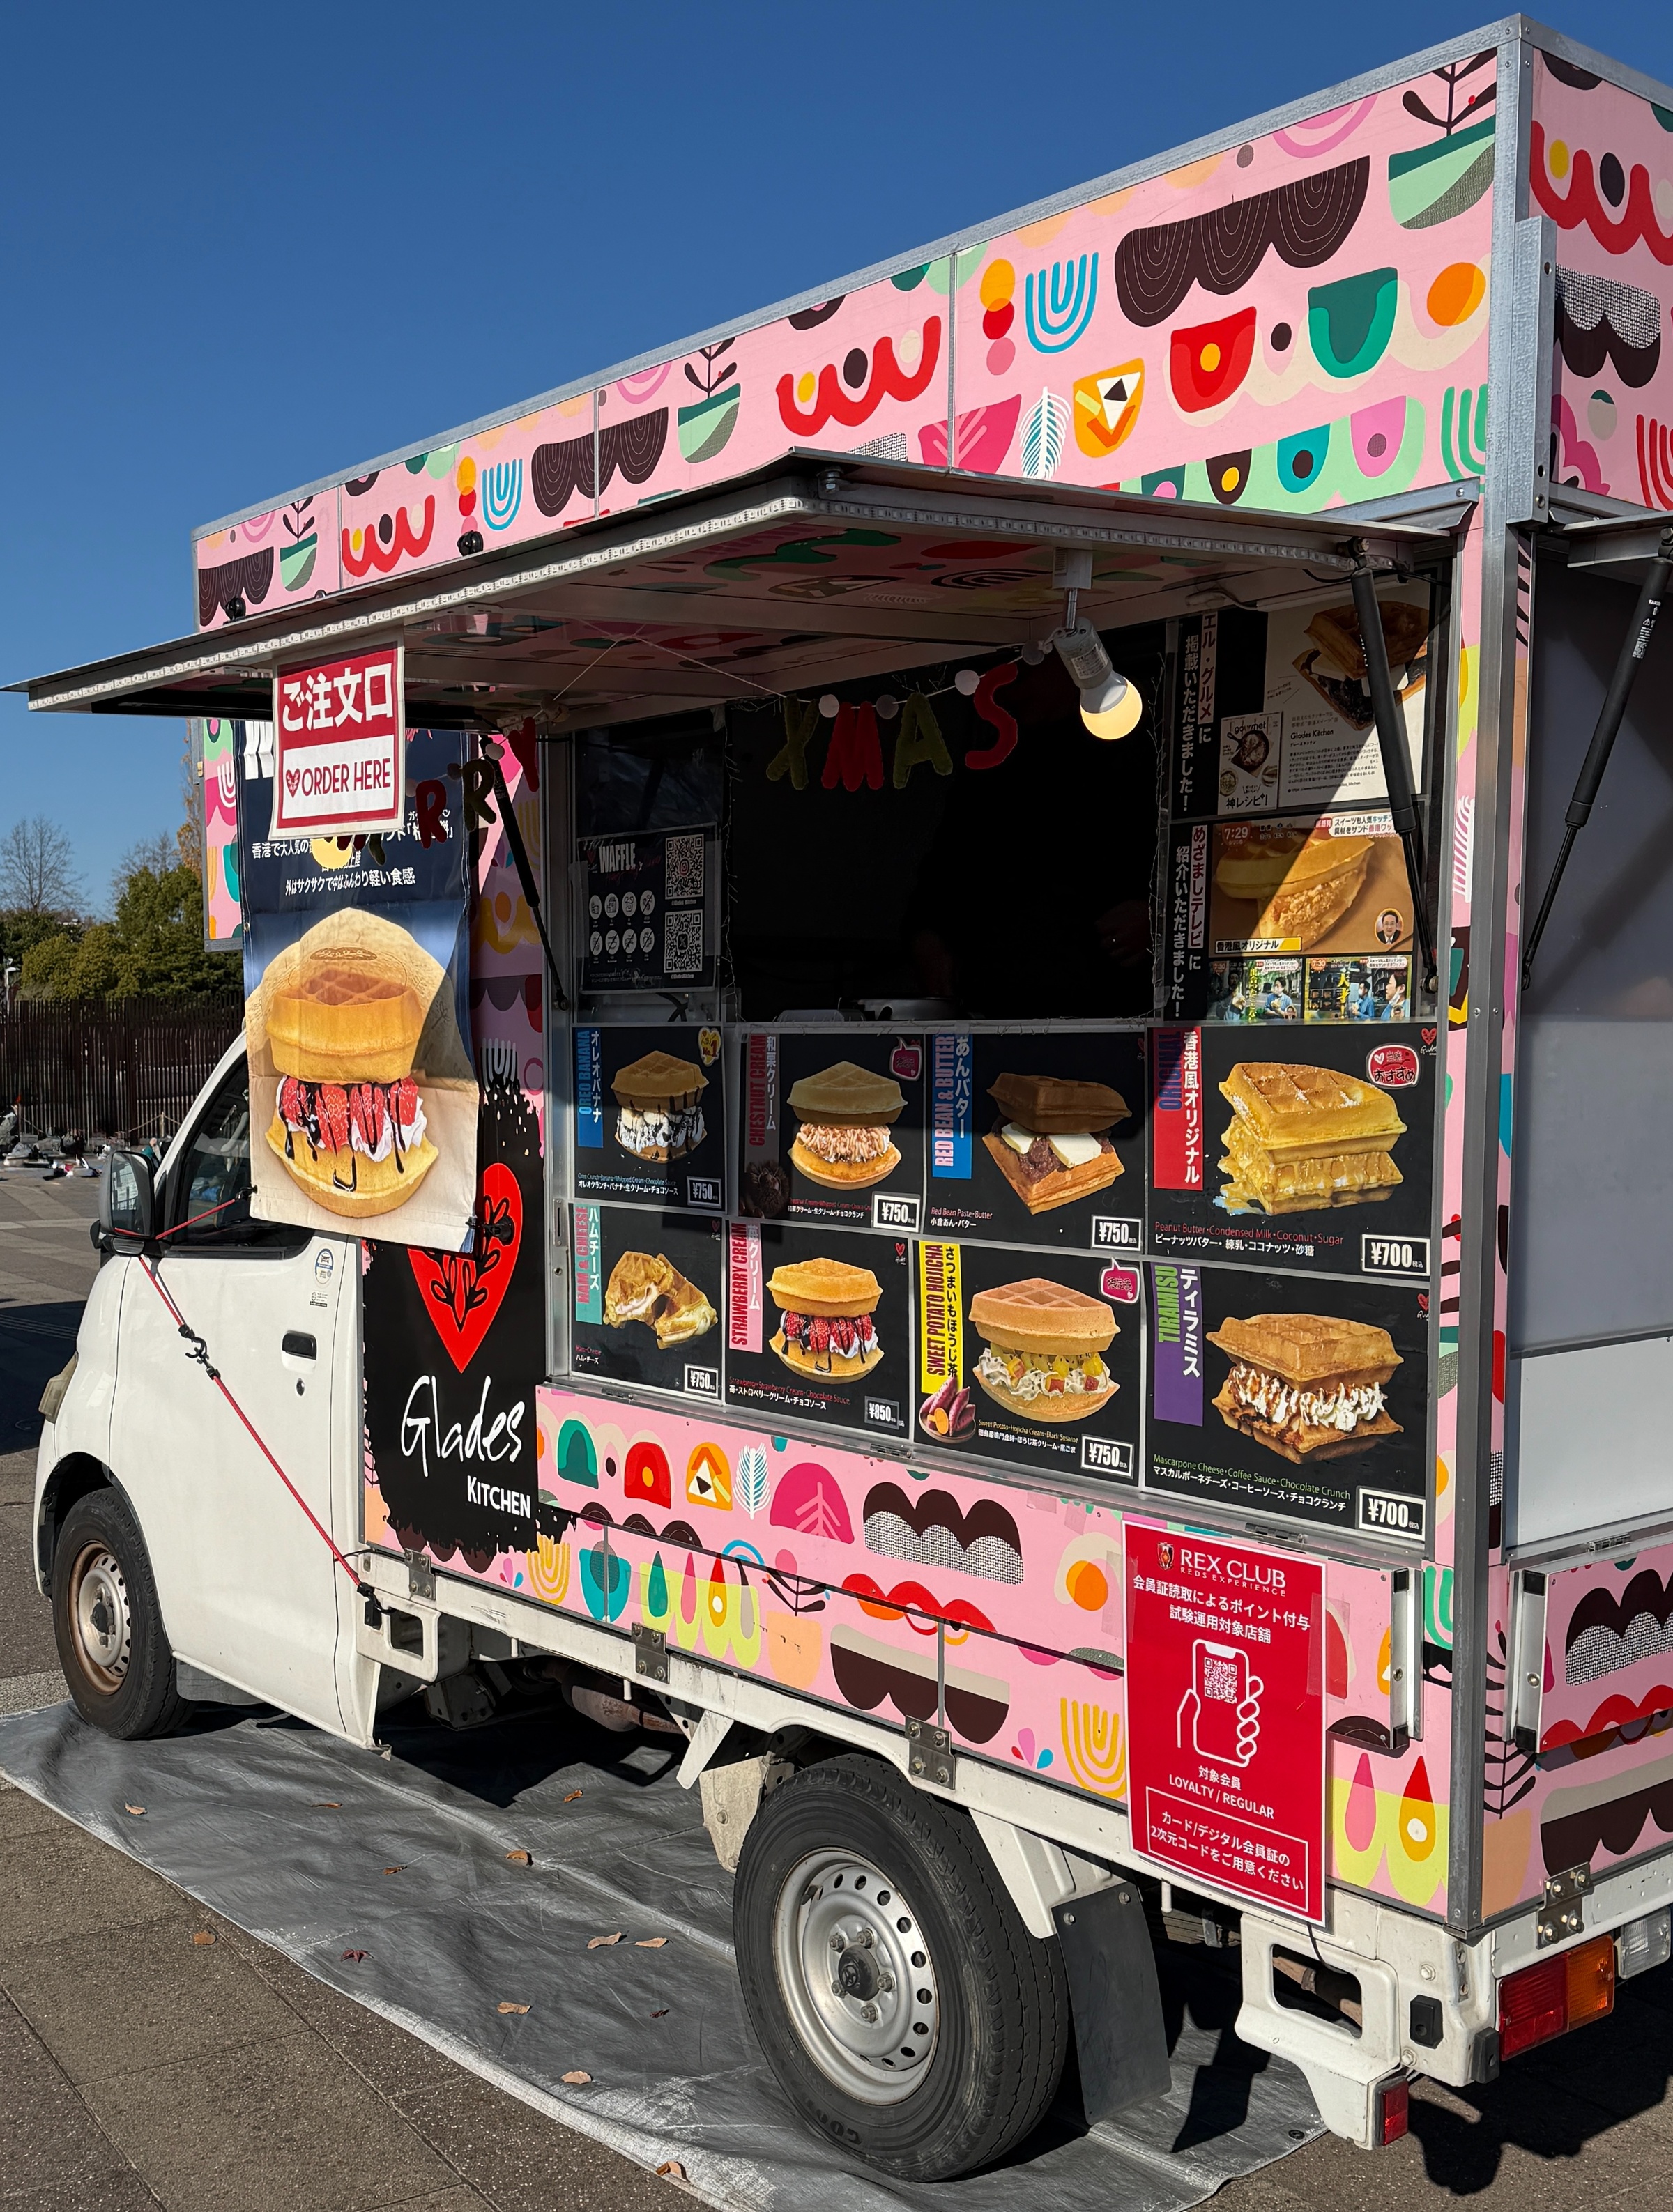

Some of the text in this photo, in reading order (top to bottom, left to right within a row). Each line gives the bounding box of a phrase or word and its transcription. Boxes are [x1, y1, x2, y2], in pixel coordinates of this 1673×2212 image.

[282, 662, 394, 732] ご注文口
[1198, 613, 1217, 744] エル・グルメに
[766, 663, 1018, 792] XMAS
[1179, 635, 1200, 811] 掲載いただきました!
[301, 758, 392, 797] ORDER HERE
[598, 843, 636, 873] WAFFLE
[1223, 827, 1248, 841] 7:29
[285, 866, 416, 896] 外はサクサクで中はふんわり軽い食感
[1188, 827, 1207, 970] めざましテレビに
[1172, 845, 1189, 1017] 紹介いただきました!
[577, 1030, 592, 1115] OREO BANANA
[591, 1030, 602, 1124] オレオバナナ
[749, 1034, 766, 1146] CHESTNUT CREAM
[766, 1036, 777, 1130] 和栗クリーム
[954, 1036, 970, 1139] あんバター
[1158, 1031, 1182, 1111] ORIGINAL
[1373, 1066, 1416, 1085] おすすめ
[935, 1036, 955, 1167] RED BEAN & BUTTER
[1183, 1031, 1200, 1184] 香港風オリジナル
[693, 1182, 712, 1201] ¥750
[881, 1201, 908, 1223] ¥750
[931, 1206, 942, 1215] Red
[942, 1208, 957, 1217] Bean
[576, 1206, 589, 1257] CHEESE
[588, 1208, 600, 1291] ハムチーズ
[1099, 1222, 1129, 1244] ¥750
[1155, 1221, 1181, 1233] Peanut
[1370, 1241, 1412, 1268] ¥700
[731, 1223, 747, 1346] STRAWBERRY CREAM
[1154, 1265, 1181, 1344] TIRAMISU
[924, 1245, 945, 1376] SWEET POTATO HOJICHA
[945, 1246, 958, 1378] さつまいもほうじ茶
[1180, 1268, 1200, 1378] ティラミス
[690, 1369, 710, 1390] ¥750
[833, 1395, 850, 1404] Sauce
[400, 1375, 526, 1477] Glades
[869, 1403, 892, 1422] ¥850
[1088, 1443, 1120, 1467] ¥750
[1154, 1454, 1196, 1470] Mascarpone
[1322, 1485, 1351, 1500] Crunch
[467, 1475, 530, 1519] KITCHEN
[1153, 1466, 1346, 1511] マスカルポーネチーズ・コーヒーソース・チョコクランチ
[1368, 1498, 1409, 1528] ¥700
[1180, 1549, 1286, 1588] REX CLUB
[1180, 1567, 1286, 1597] REDS EXPERIENCE
[1133, 1574, 1311, 1631] 会員証読取によるポイント付与
[1169, 1604, 1271, 1644] 試験運用対象店舗
[1169, 1774, 1214, 1800] LOYALTY
[1223, 1792, 1274, 1820] REGULAR
[1198, 1765, 1242, 1791] 対象会員
[1150, 1825, 1304, 1891] 2次元コードをご用意ください
[1162, 1811, 1290, 1867] カード/デジタル会員証の
